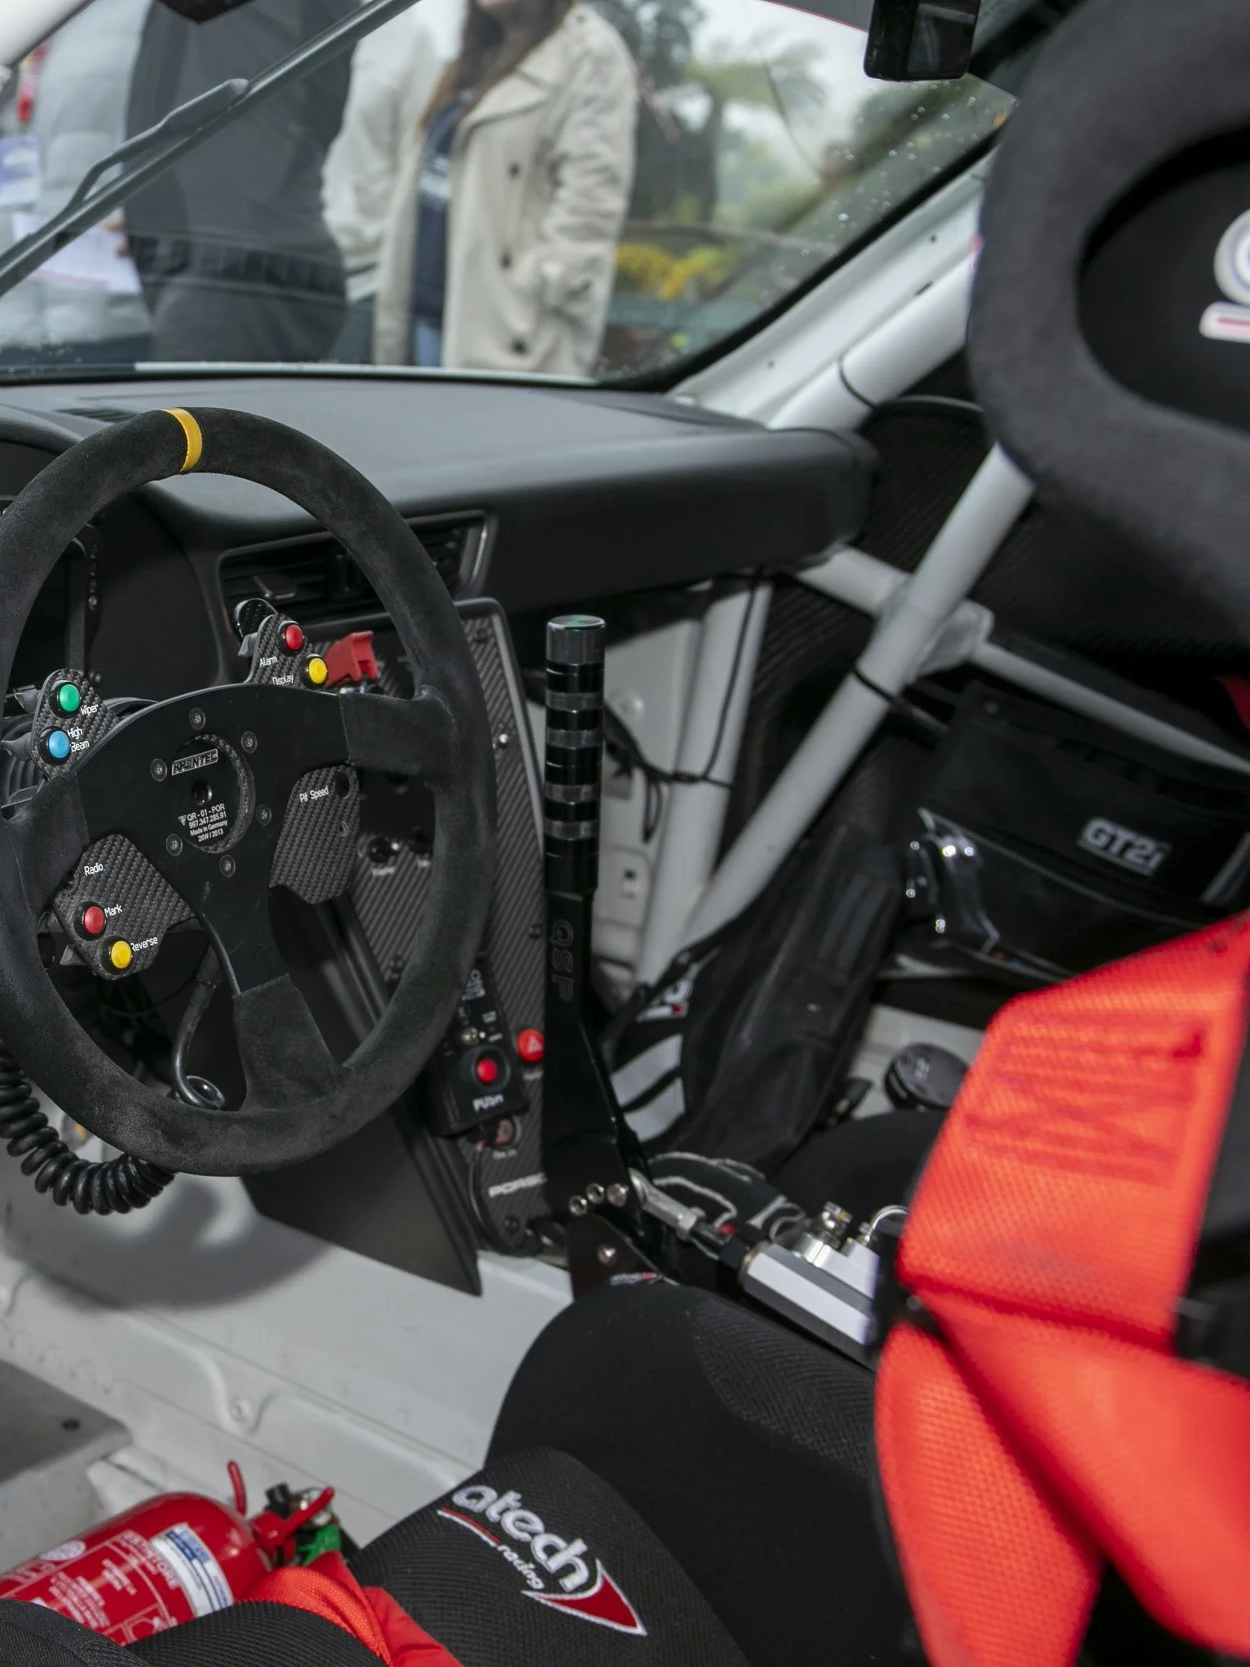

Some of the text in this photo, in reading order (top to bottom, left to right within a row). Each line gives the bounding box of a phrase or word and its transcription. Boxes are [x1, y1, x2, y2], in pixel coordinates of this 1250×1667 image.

[260, 656, 277, 667] Alarm
[81, 704, 98, 716] Wiper
[67, 727, 83, 739] High
[70, 741, 90, 752] Beam
[300, 786, 329, 802] Pit Speed
[200, 809, 207, 817] 01
[211, 803, 225, 813] POR
[190, 828, 203, 836] Made
[208, 820, 227, 831] Germany
[84, 863, 104, 876] Radio
[104, 904, 123, 917] Mark
[130, 937, 158, 952] Reverse
[473, 1094, 504, 1111] PUSH
[452, 1485, 589, 1592] atech
[497, 1544, 545, 1590] racing
